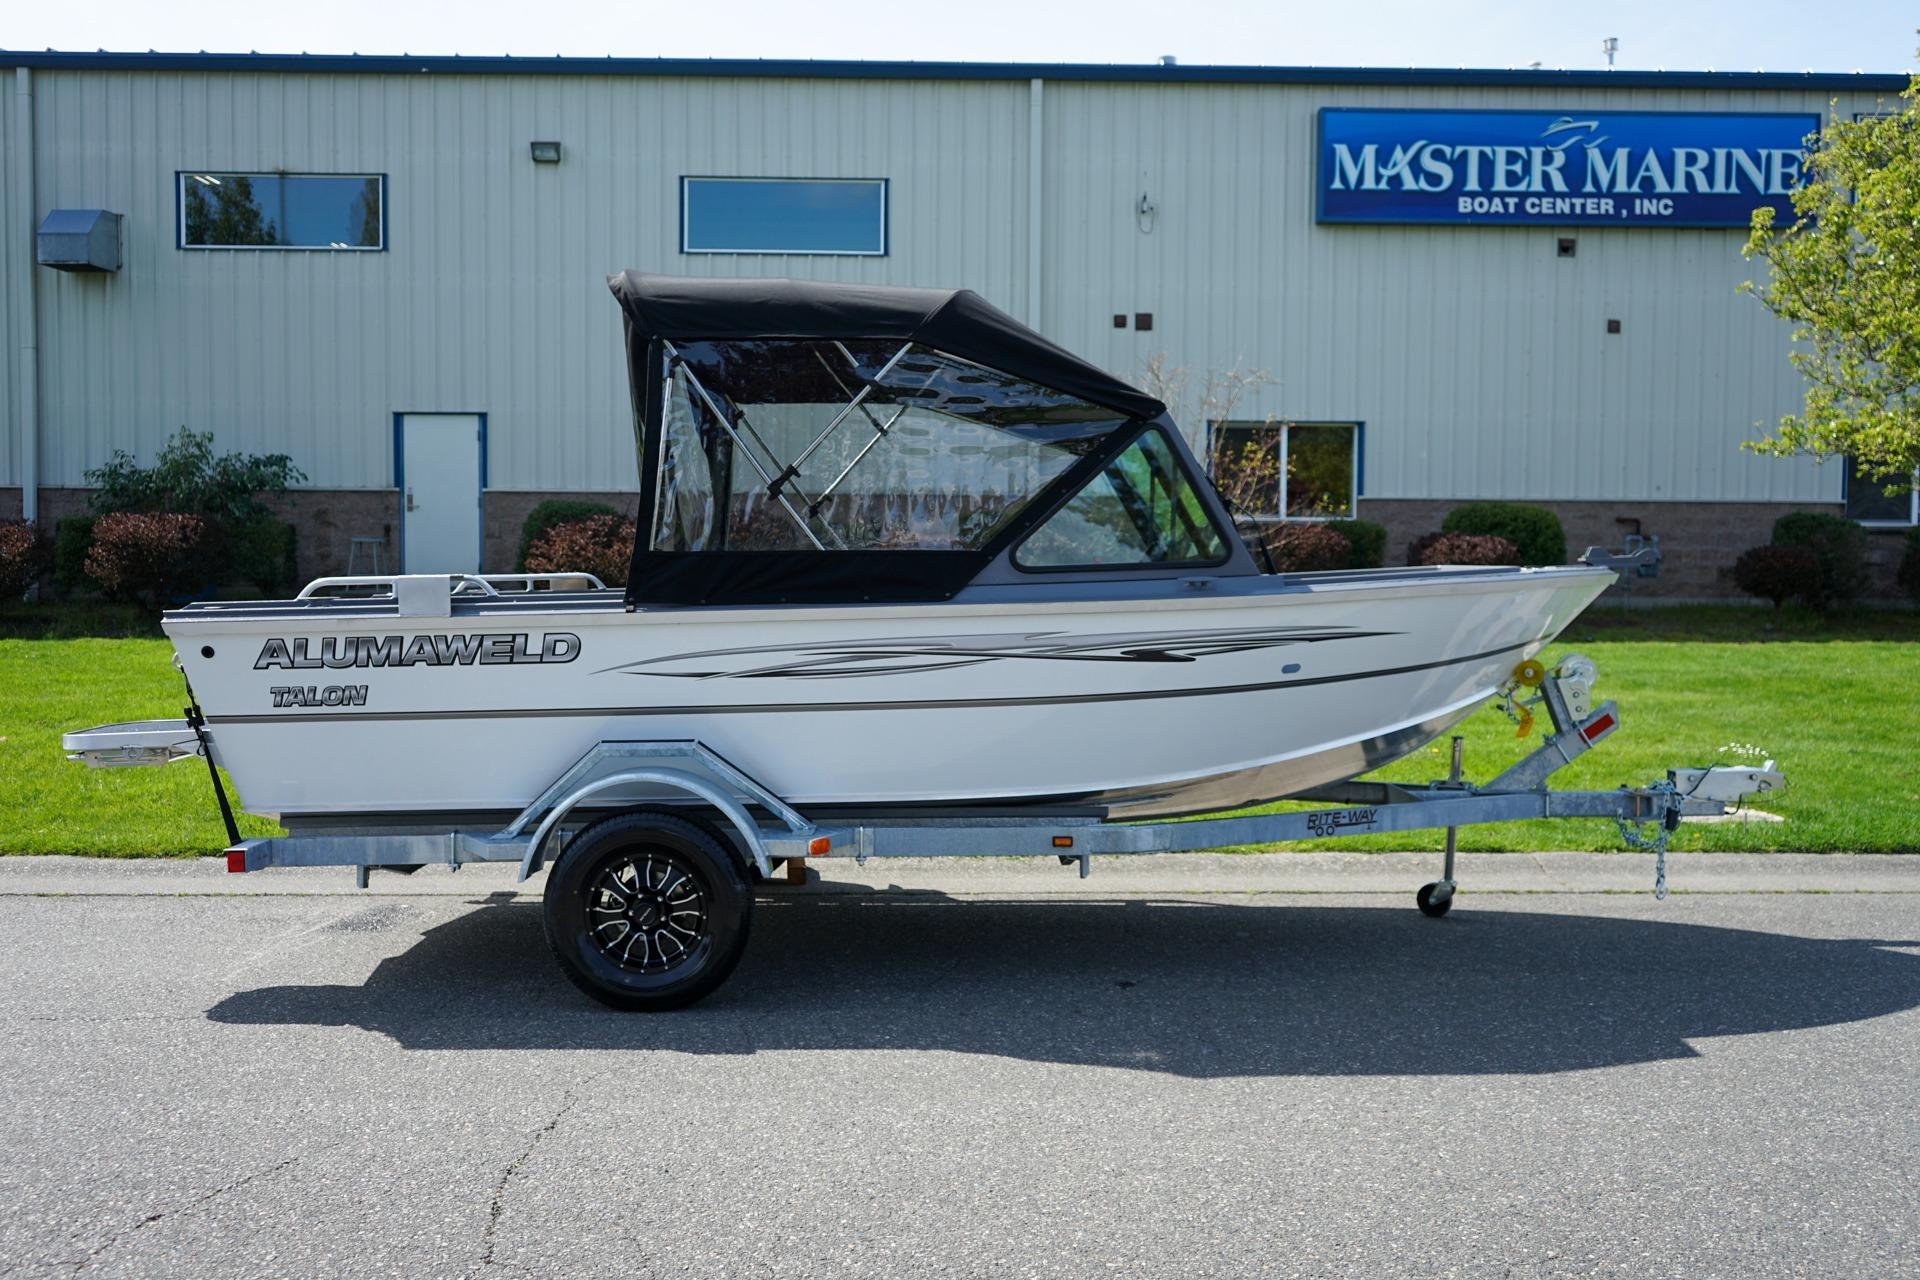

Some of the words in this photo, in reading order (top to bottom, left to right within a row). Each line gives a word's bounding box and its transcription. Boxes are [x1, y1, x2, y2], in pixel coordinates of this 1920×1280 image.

[1330, 140, 1570, 193] MASTER
[1581, 146, 1806, 196] MARINE
[1458, 196, 1519, 214] BOAT
[1634, 198, 1674, 216] INC
[253, 632, 582, 670] ALUMAWELD
[270, 684, 368, 708] TALON
[1307, 808, 1378, 827] RITE-WAY
